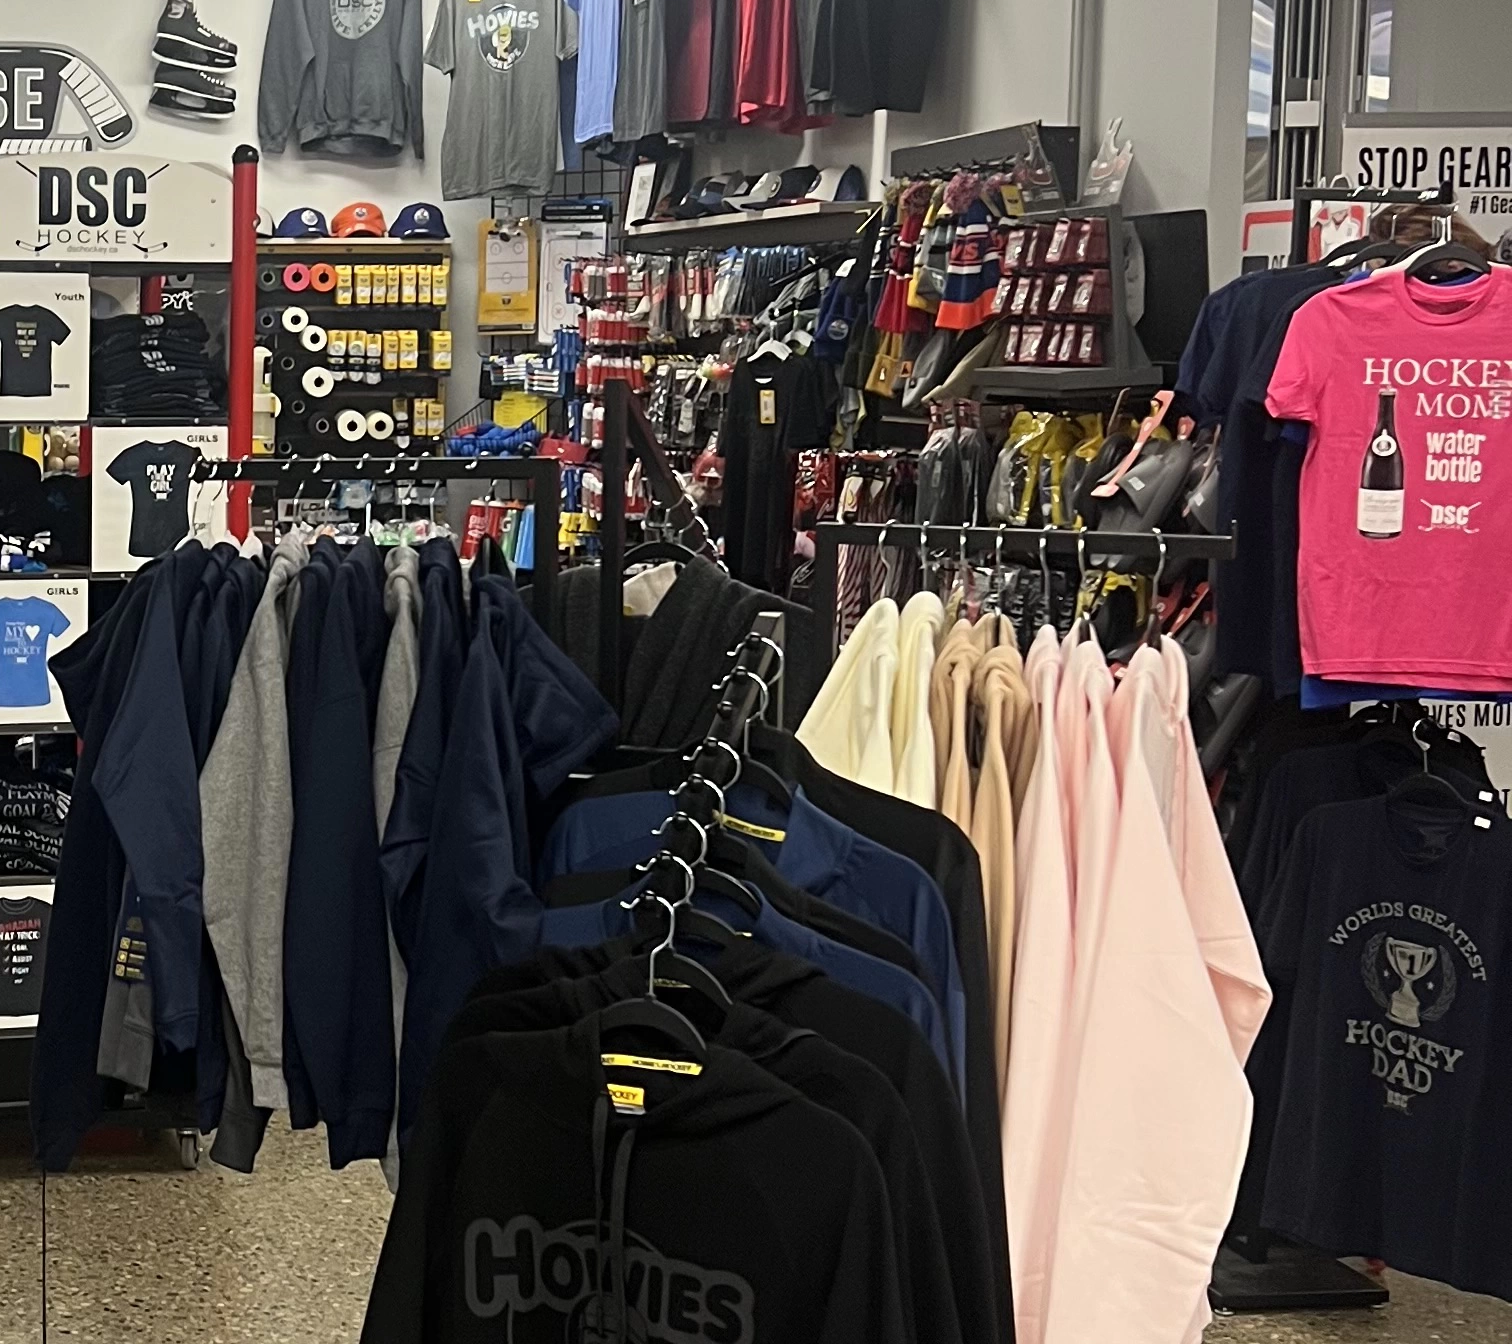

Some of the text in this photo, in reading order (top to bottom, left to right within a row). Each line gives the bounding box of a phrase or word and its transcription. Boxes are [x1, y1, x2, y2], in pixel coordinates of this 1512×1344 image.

[467, 10, 539, 38] HOWIES
[1358, 147, 1512, 188] STOP GEAR
[37, 166, 147, 227] DSC
[1470, 196, 1487, 214] #1
[37, 229, 146, 245] HOCKEY
[54, 292, 85, 301] Youth
[1416, 393, 1502, 420] MOM
[186, 434, 219, 443] GIRLS
[1426, 430, 1486, 457] water
[146, 464, 176, 476] PLAY
[1425, 454, 1482, 483] bottle
[501, 517, 512, 532] G
[1431, 504, 1469, 525] DSC
[46, 587, 79, 595] GIRLS
[3, 646, 41, 655] HOCKEY
[3, 804, 36, 817] GOAL
[1328, 901, 1487, 983] WORLDS GREATEST
[1404, 951, 1418, 976] 1
[1346, 1019, 1464, 1074] HOCKEY
[1371, 1048, 1433, 1094] DAD
